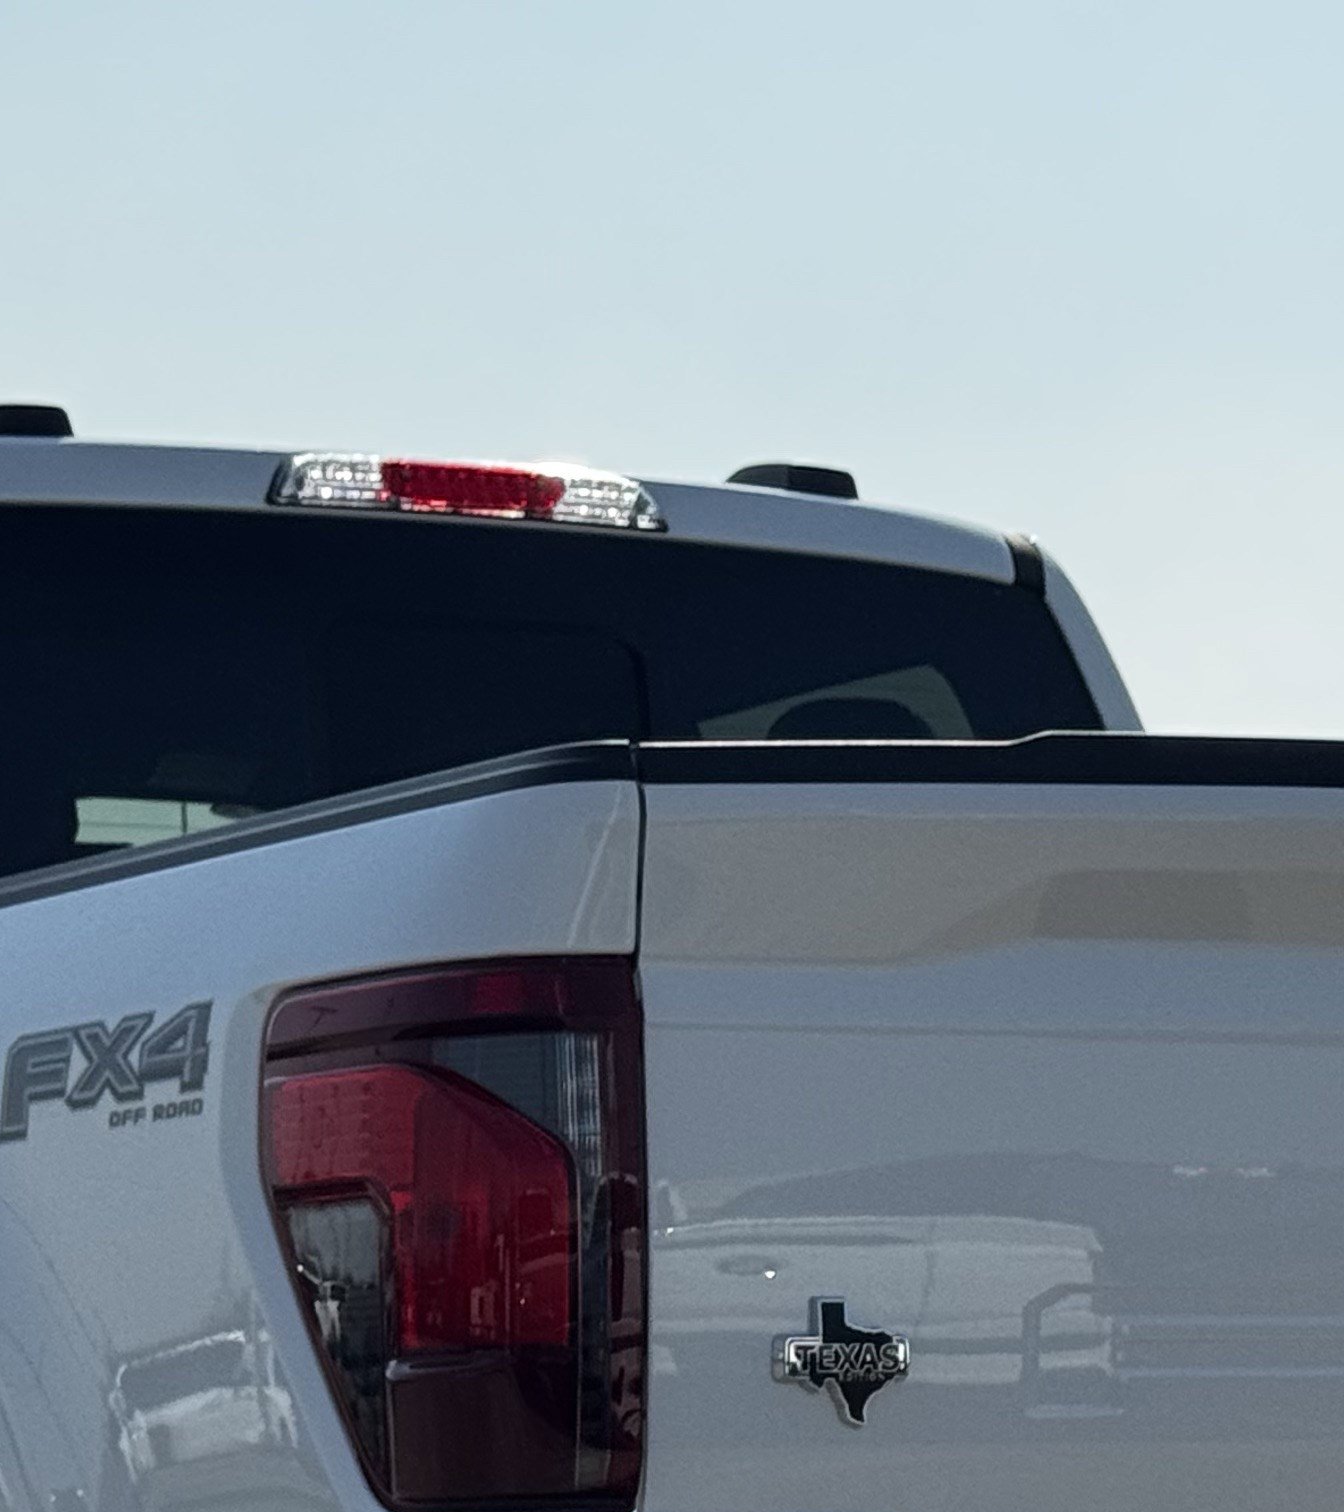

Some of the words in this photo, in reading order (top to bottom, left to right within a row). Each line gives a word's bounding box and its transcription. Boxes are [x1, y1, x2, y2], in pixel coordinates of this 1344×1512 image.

[0, 999, 214, 1144] FX4
[109, 1104, 147, 1127] OFF
[152, 1098, 204, 1123] ROAD
[794, 1343, 901, 1373] TEXAS
